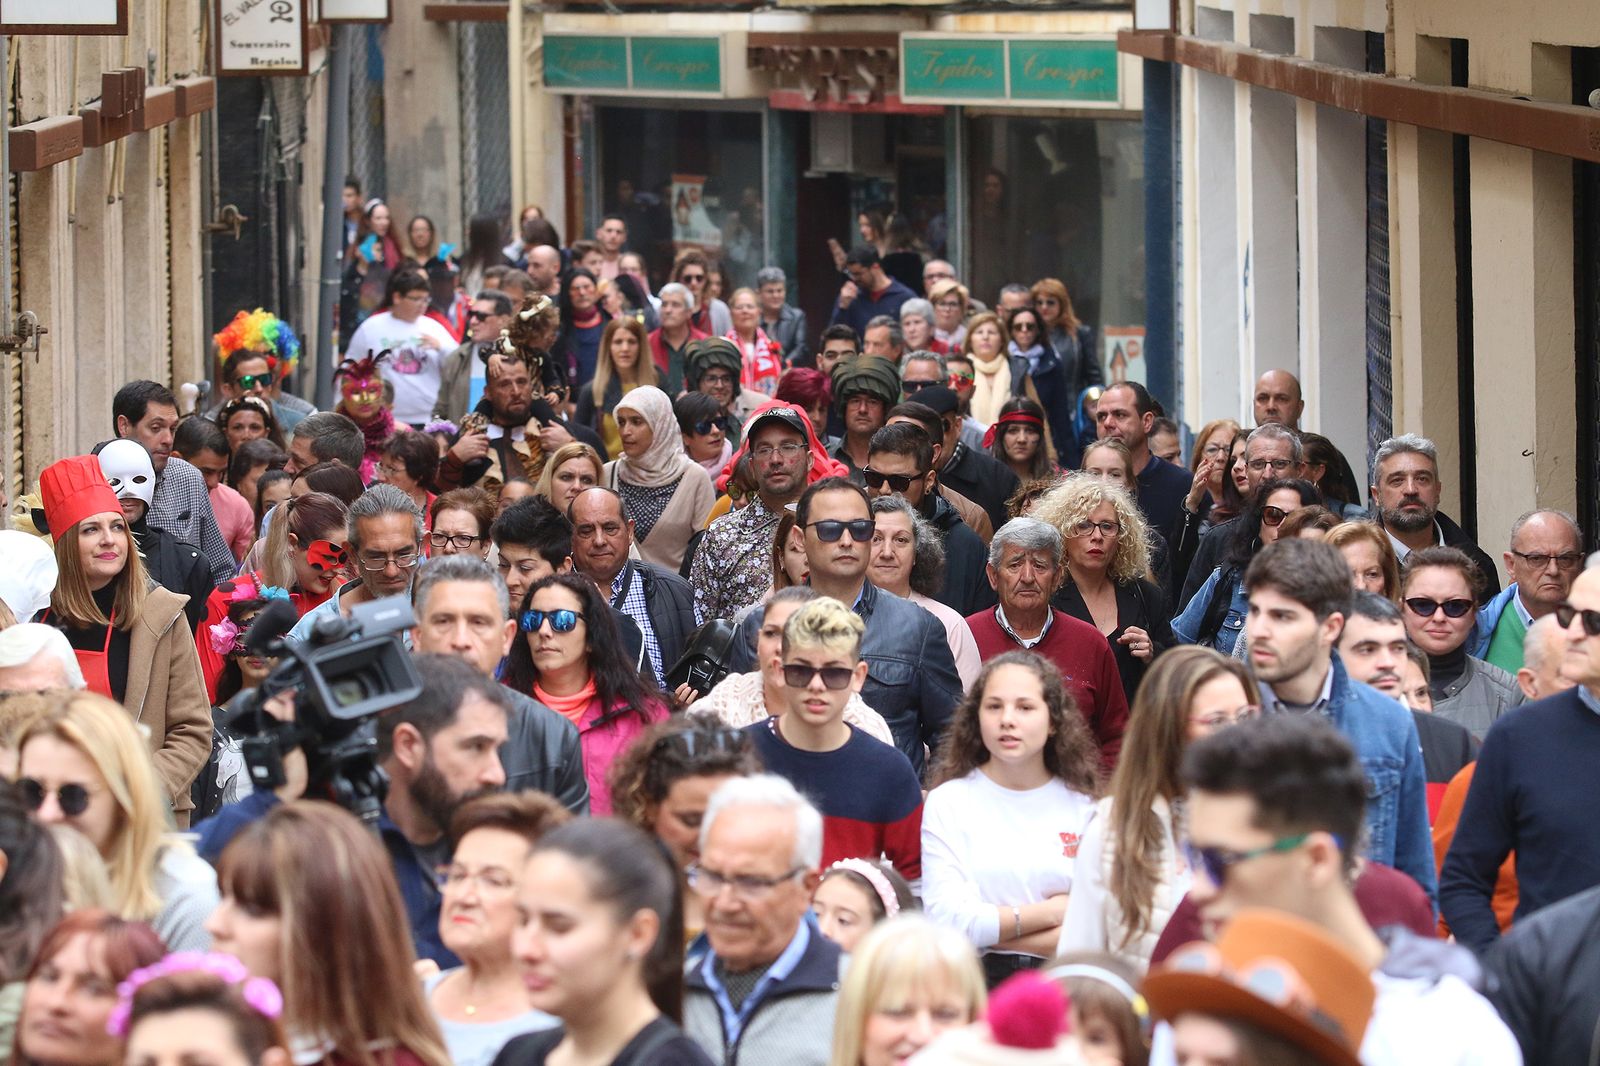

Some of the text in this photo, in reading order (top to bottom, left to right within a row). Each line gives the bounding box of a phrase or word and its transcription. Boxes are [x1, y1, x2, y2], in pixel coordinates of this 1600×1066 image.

[222, 12, 240, 26] EL
[230, 40, 291, 48] Souvenirs
[250, 57, 298, 67] Regalos
[913, 50, 993, 84] Tejidos
[1024, 53, 1105, 87] Crespo
